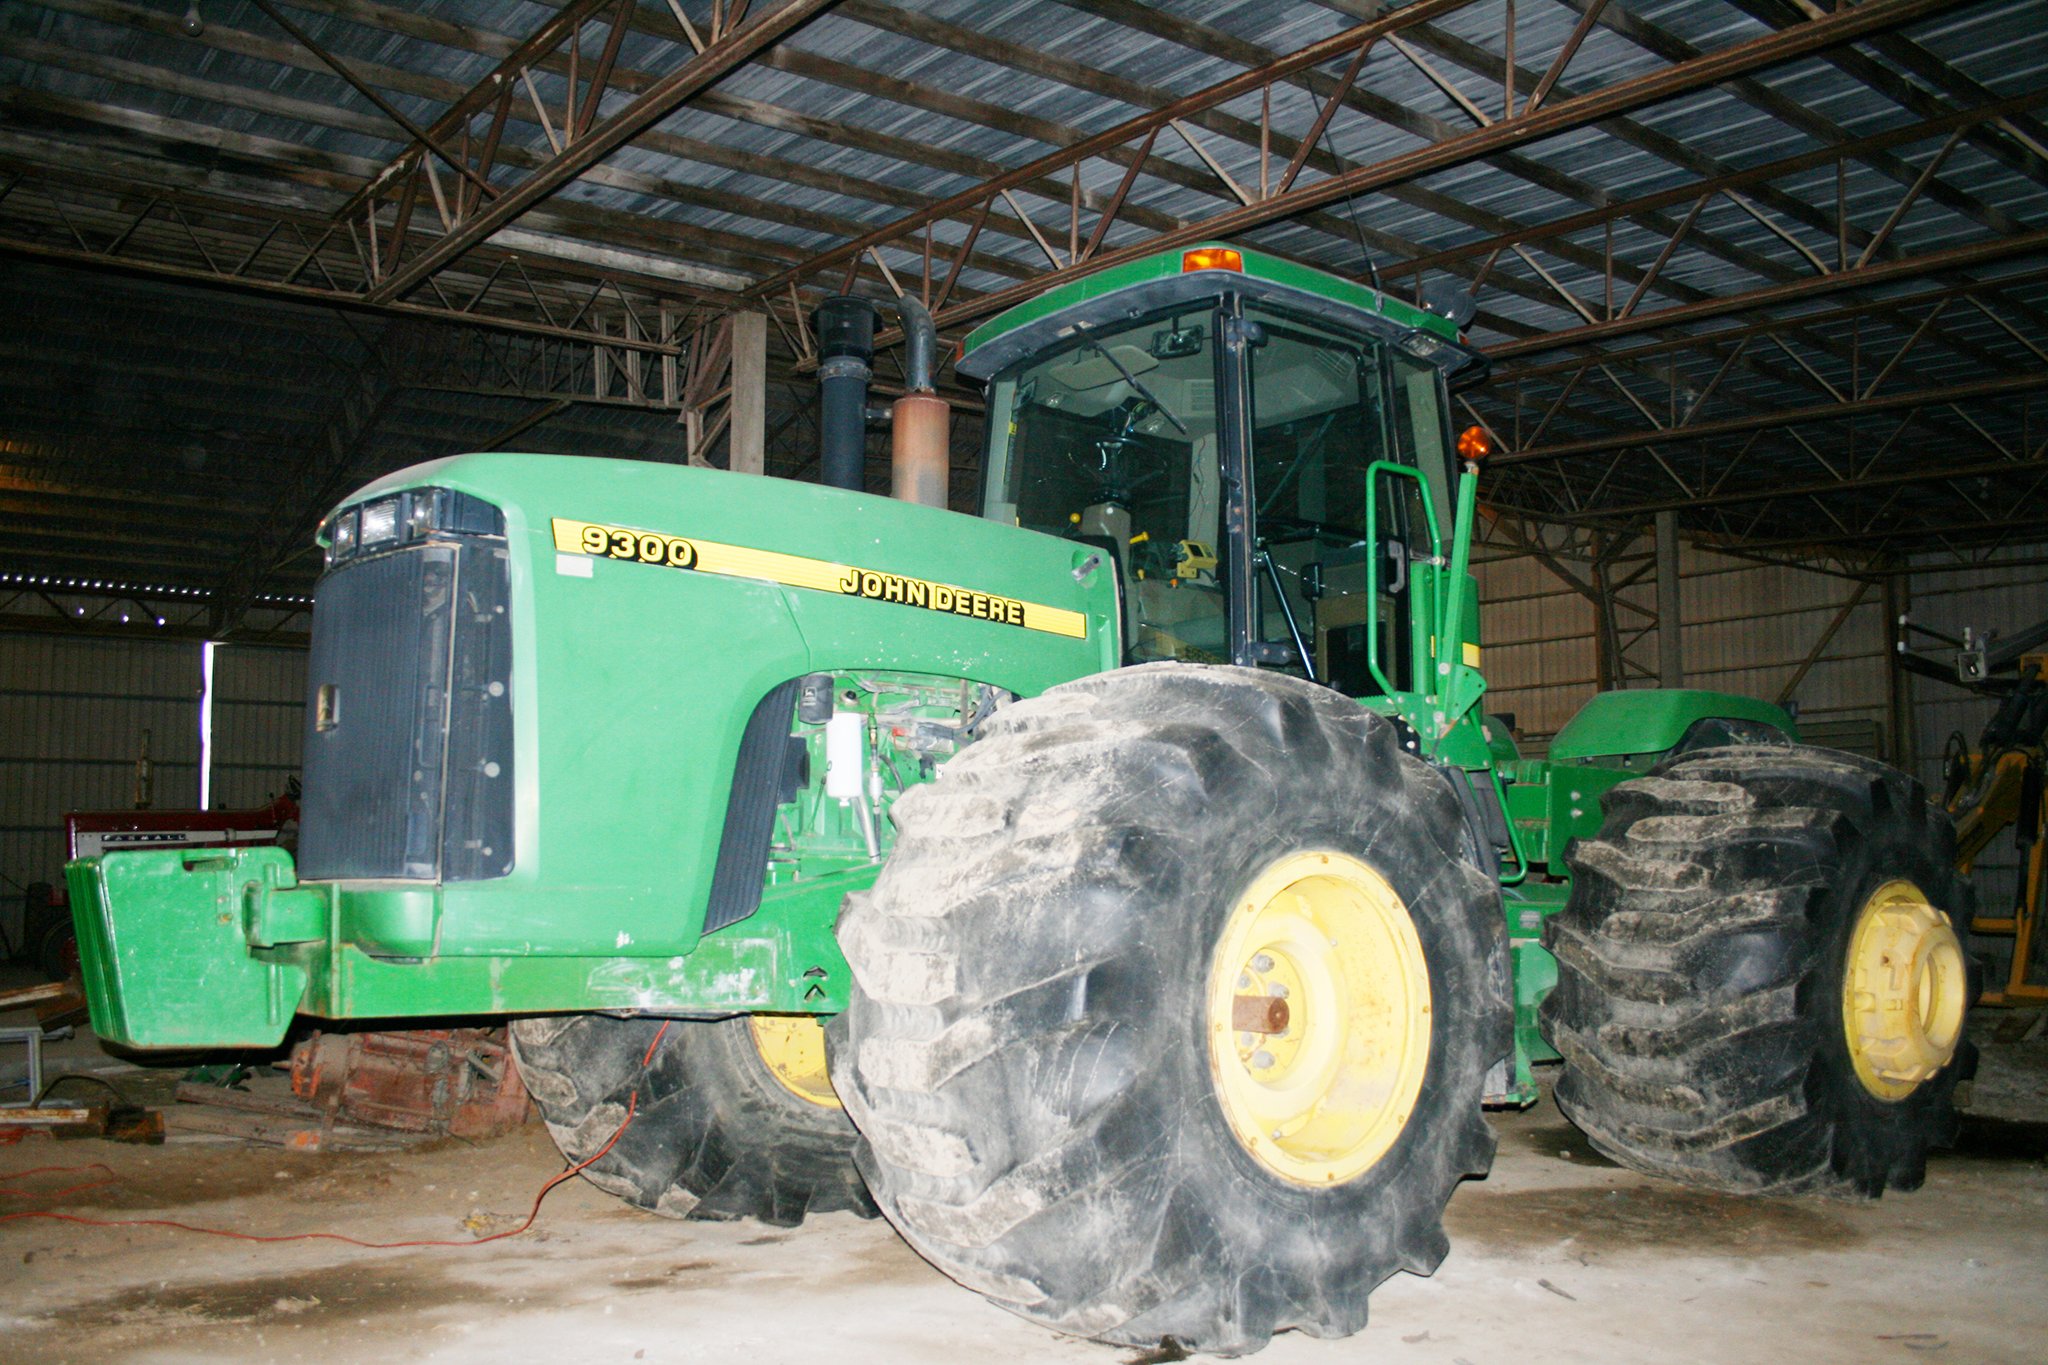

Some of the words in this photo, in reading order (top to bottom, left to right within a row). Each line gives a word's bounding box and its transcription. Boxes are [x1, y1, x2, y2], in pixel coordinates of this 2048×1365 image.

[582, 526, 698, 570] 9300
[840, 570, 930, 610] JOHN
[935, 586, 1025, 627] DEERE
[103, 833, 185, 841] FARMALL
